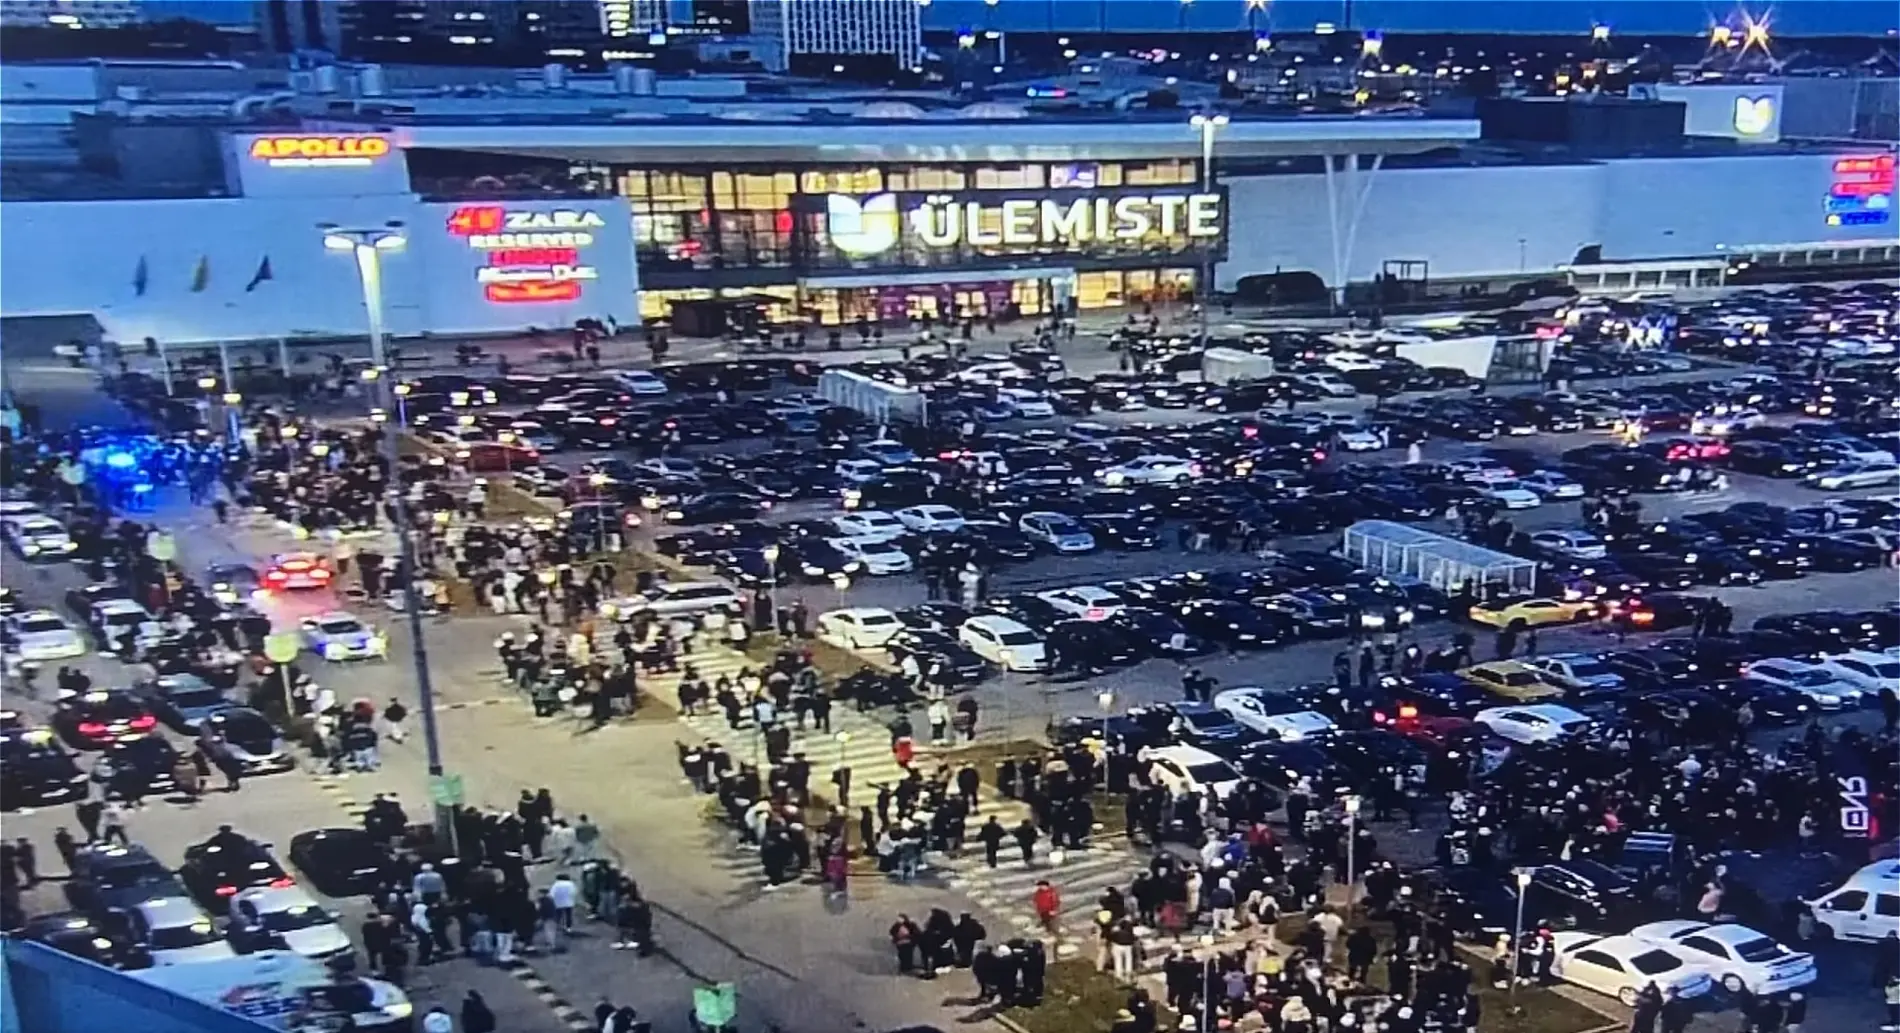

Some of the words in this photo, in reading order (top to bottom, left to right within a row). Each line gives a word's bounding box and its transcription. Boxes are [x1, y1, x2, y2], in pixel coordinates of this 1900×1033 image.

[250, 138, 389, 157] APOLLO
[504, 211, 606, 227] ZARA
[920, 194, 1221, 246] ÜLEMISTE
